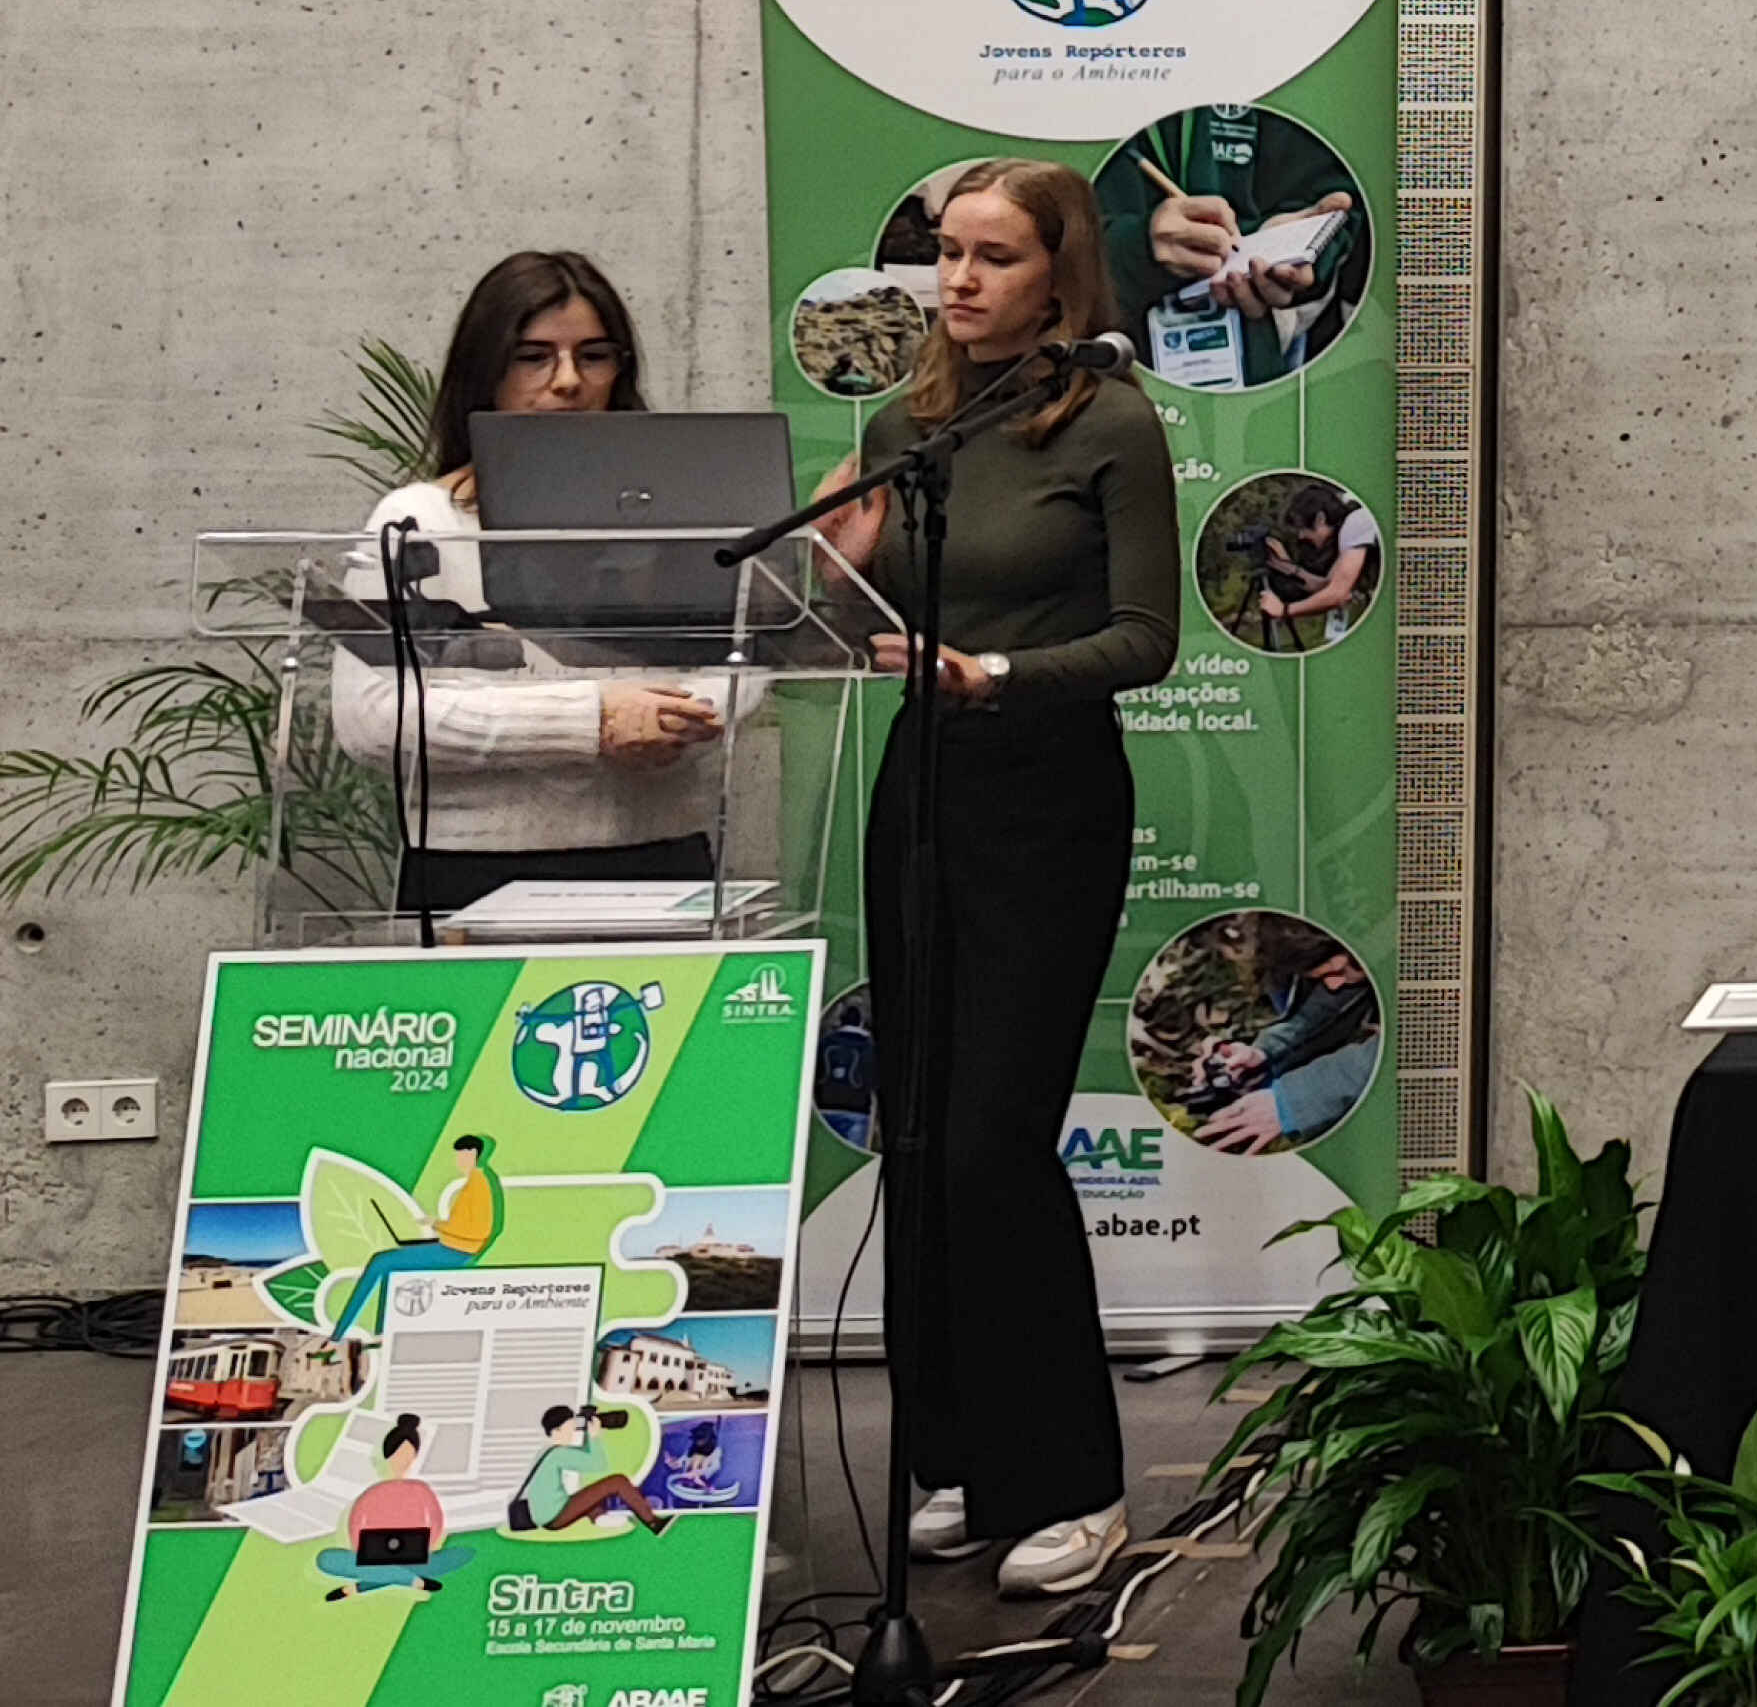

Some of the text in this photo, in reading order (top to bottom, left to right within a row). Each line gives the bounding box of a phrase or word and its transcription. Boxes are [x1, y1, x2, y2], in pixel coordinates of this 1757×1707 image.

[980, 43, 1187, 61] Jovens Repórteres
[993, 64, 1172, 86] para o Ambiente
[1185, 653, 1250, 675] vídeo
[1197, 709, 1259, 731] local.
[722, 1003, 794, 1017] SINTRA
[252, 1005, 457, 1047] SEMINÁRIO
[335, 1040, 454, 1069] nacional
[390, 1070, 449, 1092] 2024
[1062, 1128, 1164, 1169] AAE
[1086, 1213, 1201, 1242] .abae.pt
[441, 1284, 496, 1296] Jovens
[464, 1296, 590, 1315] para o Ambiente
[487, 1574, 635, 1615] Sintra
[487, 1613, 687, 1637] 15 a 17 de novembro
[635, 1635, 675, 1651] Santa
[678, 1635, 717, 1649] Maria
